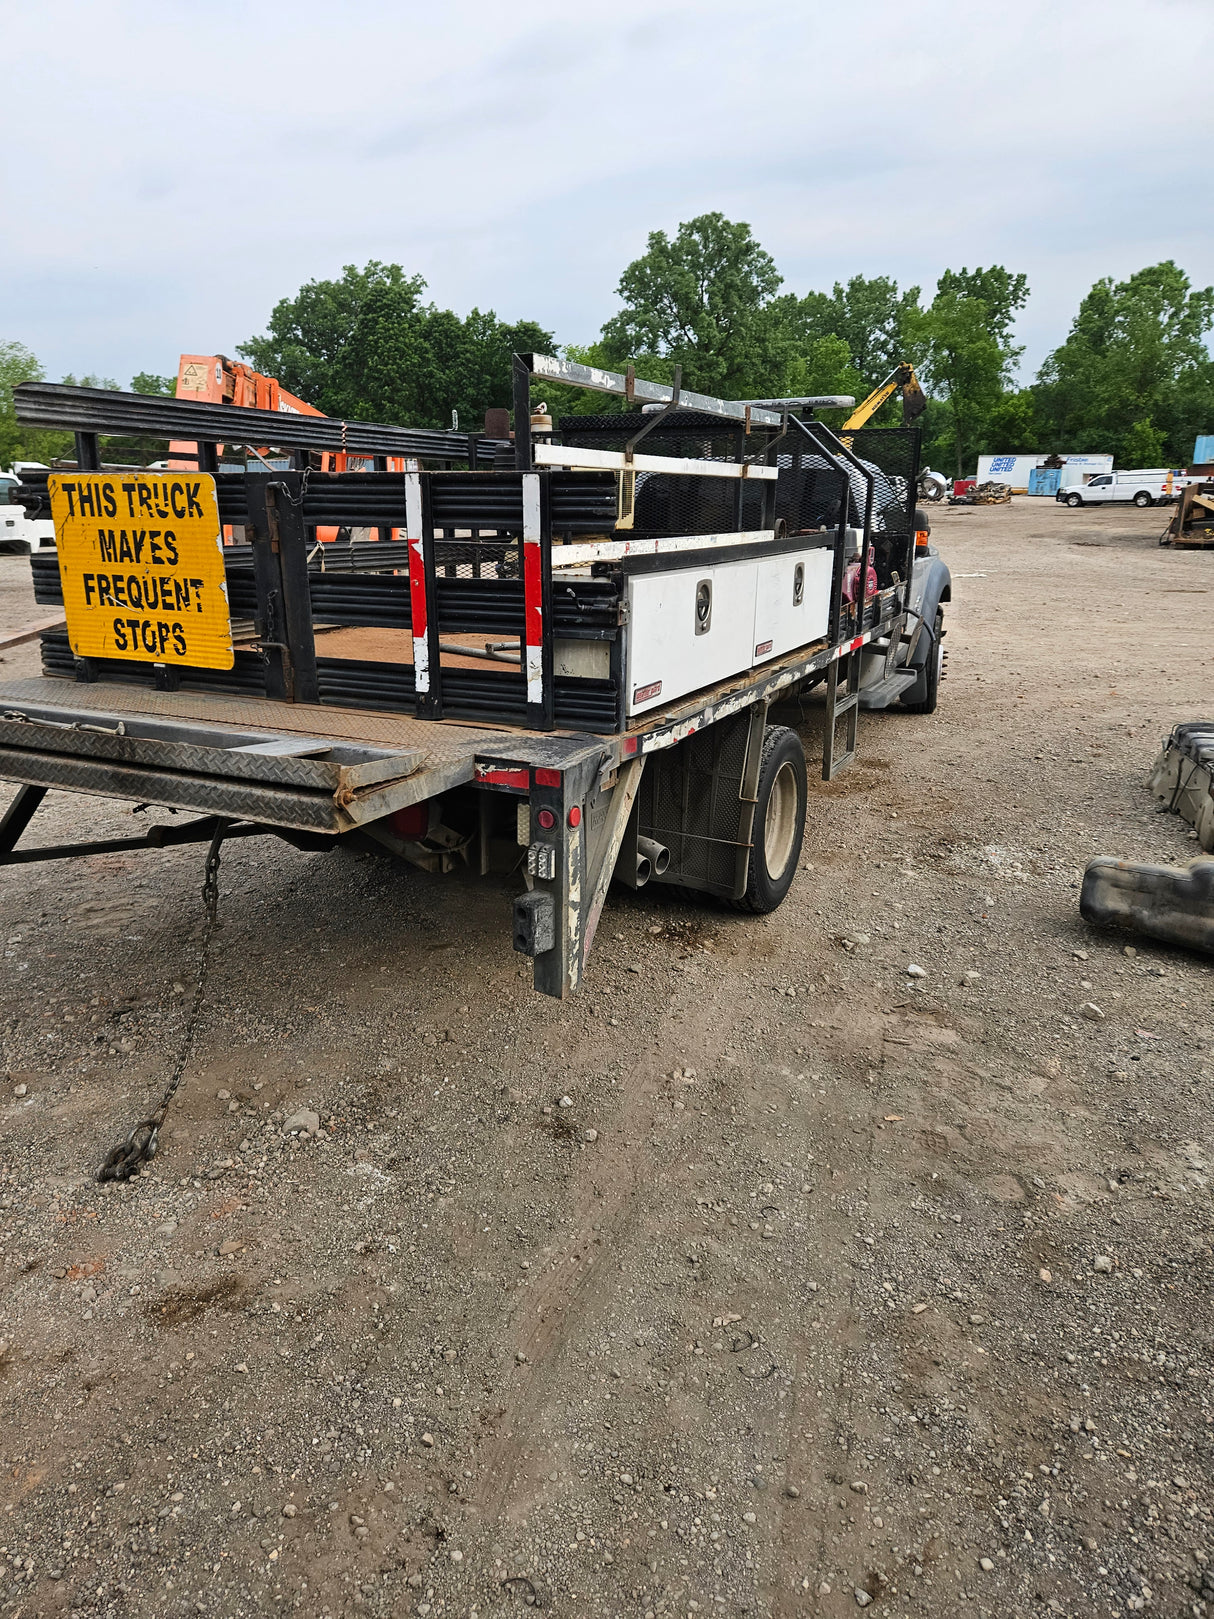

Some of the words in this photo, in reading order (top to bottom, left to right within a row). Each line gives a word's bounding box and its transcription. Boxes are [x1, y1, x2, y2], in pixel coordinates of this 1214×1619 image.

[61, 482, 118, 518] THIS
[122, 482, 205, 519] TRUCK
[98, 528, 179, 566] MAKES
[82, 573, 205, 613] FREQUENT
[113, 617, 187, 657] STOPS
